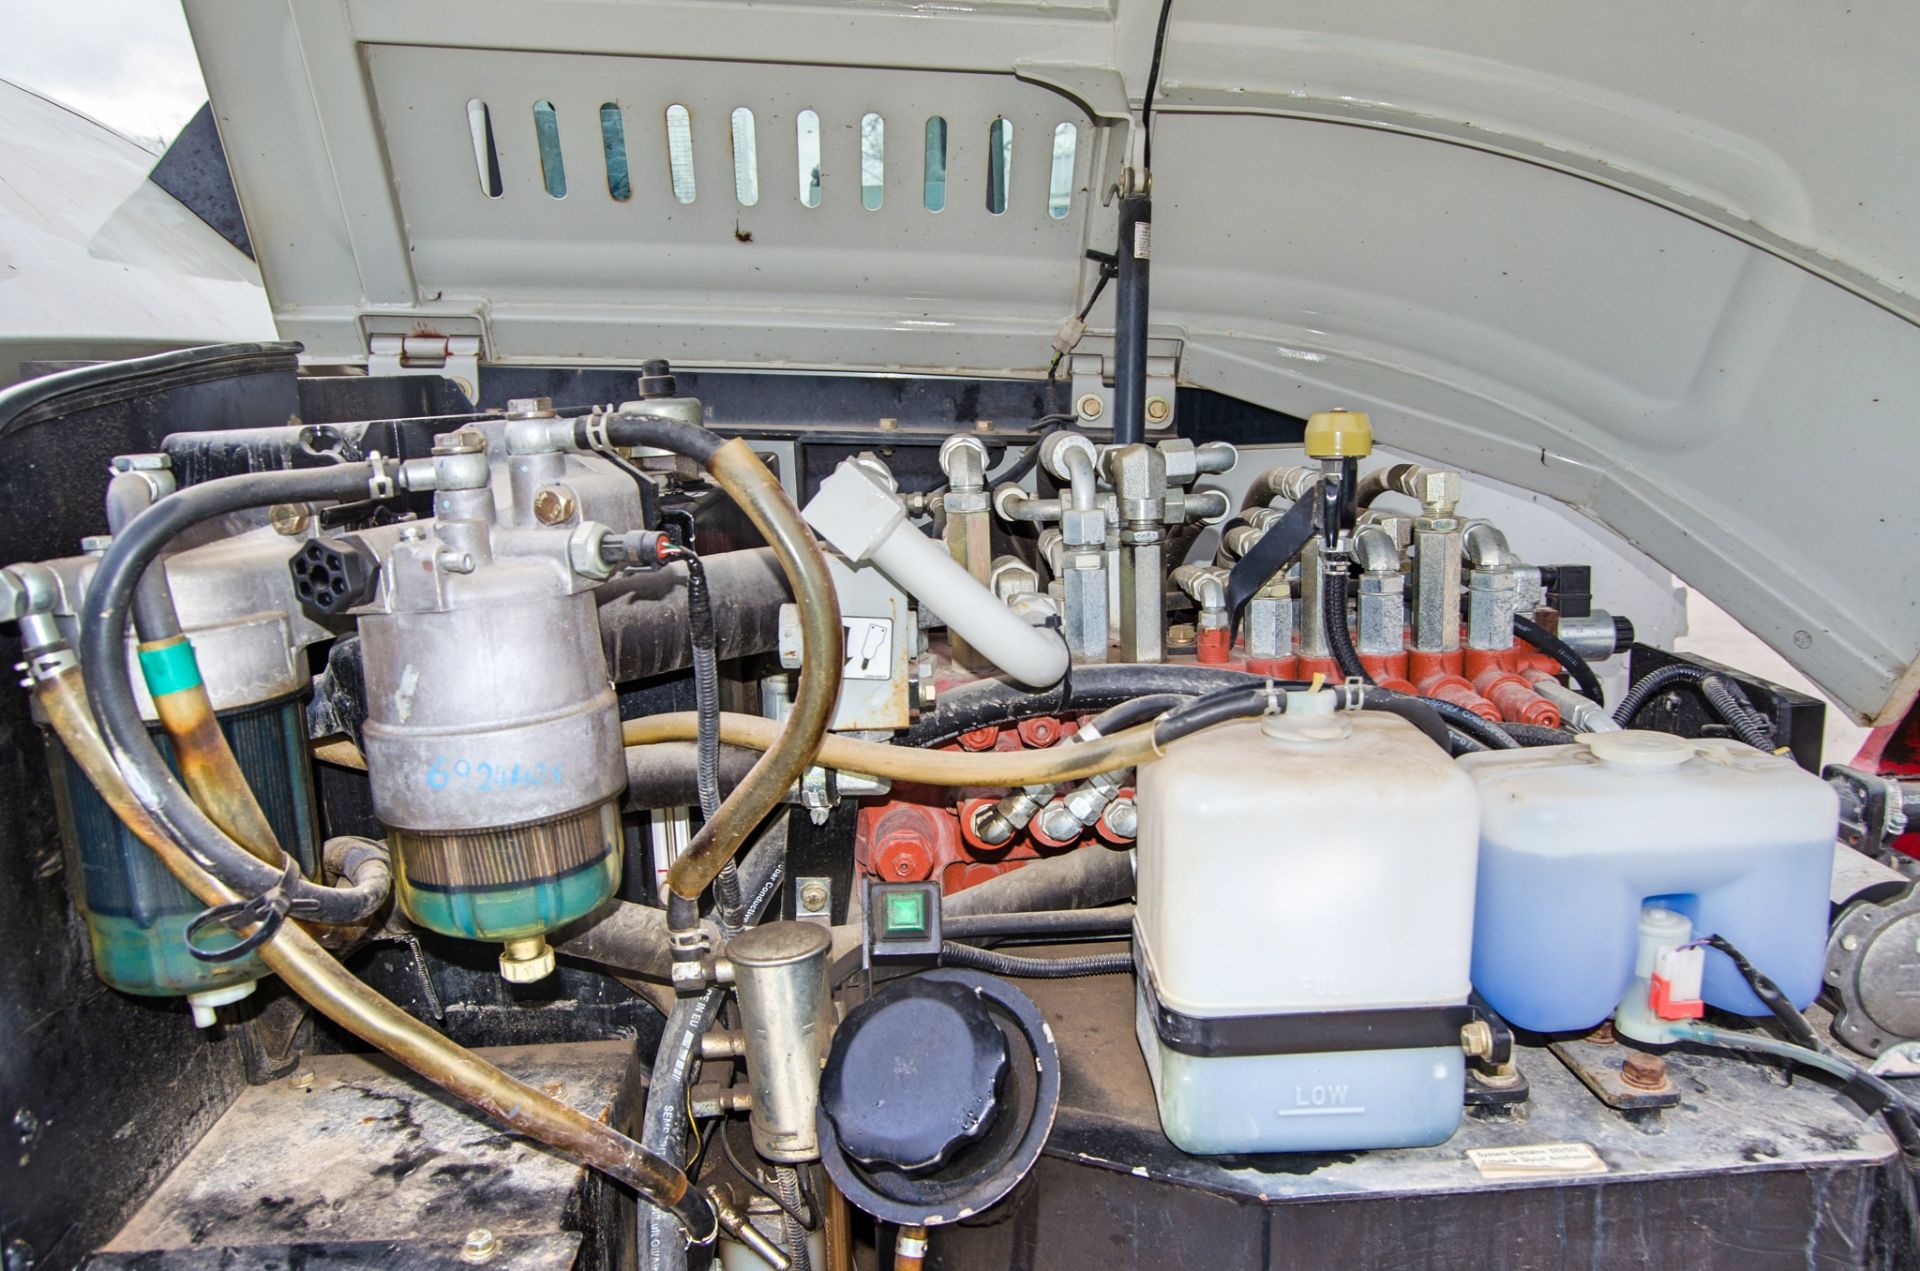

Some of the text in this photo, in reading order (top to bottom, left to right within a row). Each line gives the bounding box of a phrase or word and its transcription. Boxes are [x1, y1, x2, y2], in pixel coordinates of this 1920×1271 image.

[695, 1002, 705, 1014] IN
[689, 1014, 701, 1028] EU
[1295, 1085, 1349, 1106] LOW
